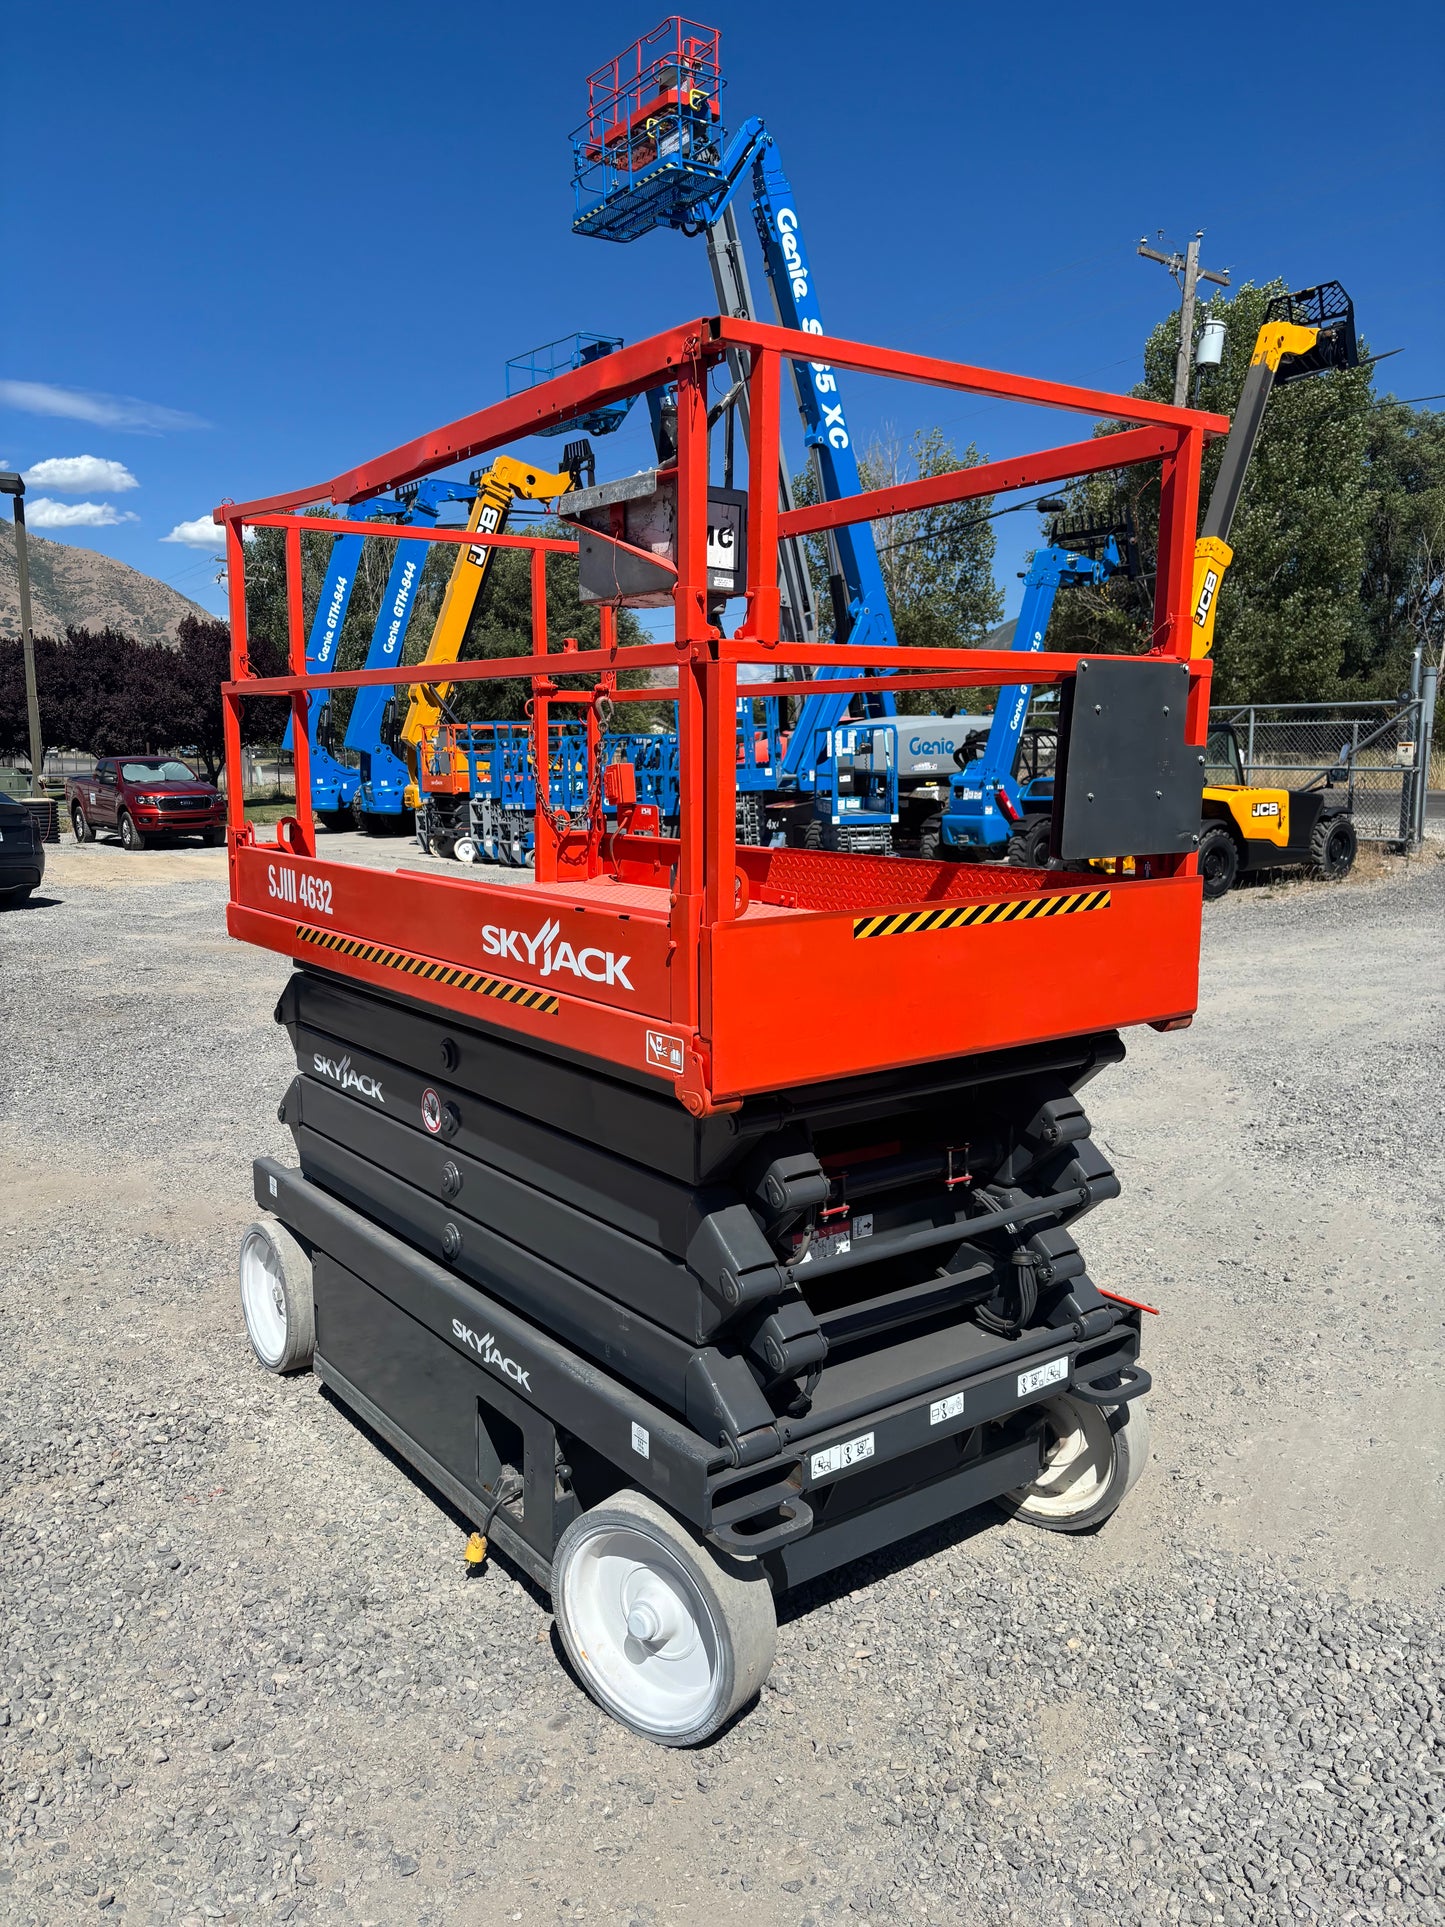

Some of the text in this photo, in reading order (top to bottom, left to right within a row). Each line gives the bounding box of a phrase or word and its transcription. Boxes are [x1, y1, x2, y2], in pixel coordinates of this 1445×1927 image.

[777, 207, 808, 300] Genie
[822, 403, 849, 449] XC
[317, 576, 348, 662] Genie GTH-844
[383, 561, 417, 654] Genie GTH-844
[1197, 570, 1219, 627] JCB
[1010, 697, 1025, 731] Genie
[909, 736, 955, 756] Genie
[1252, 802, 1279, 817] JCB
[268, 864, 334, 915] SJIII 4632
[481, 917, 635, 991] SKYJACK
[313, 1052, 385, 1103] SKYJACK
[452, 1318, 532, 1393] SKYJACK
